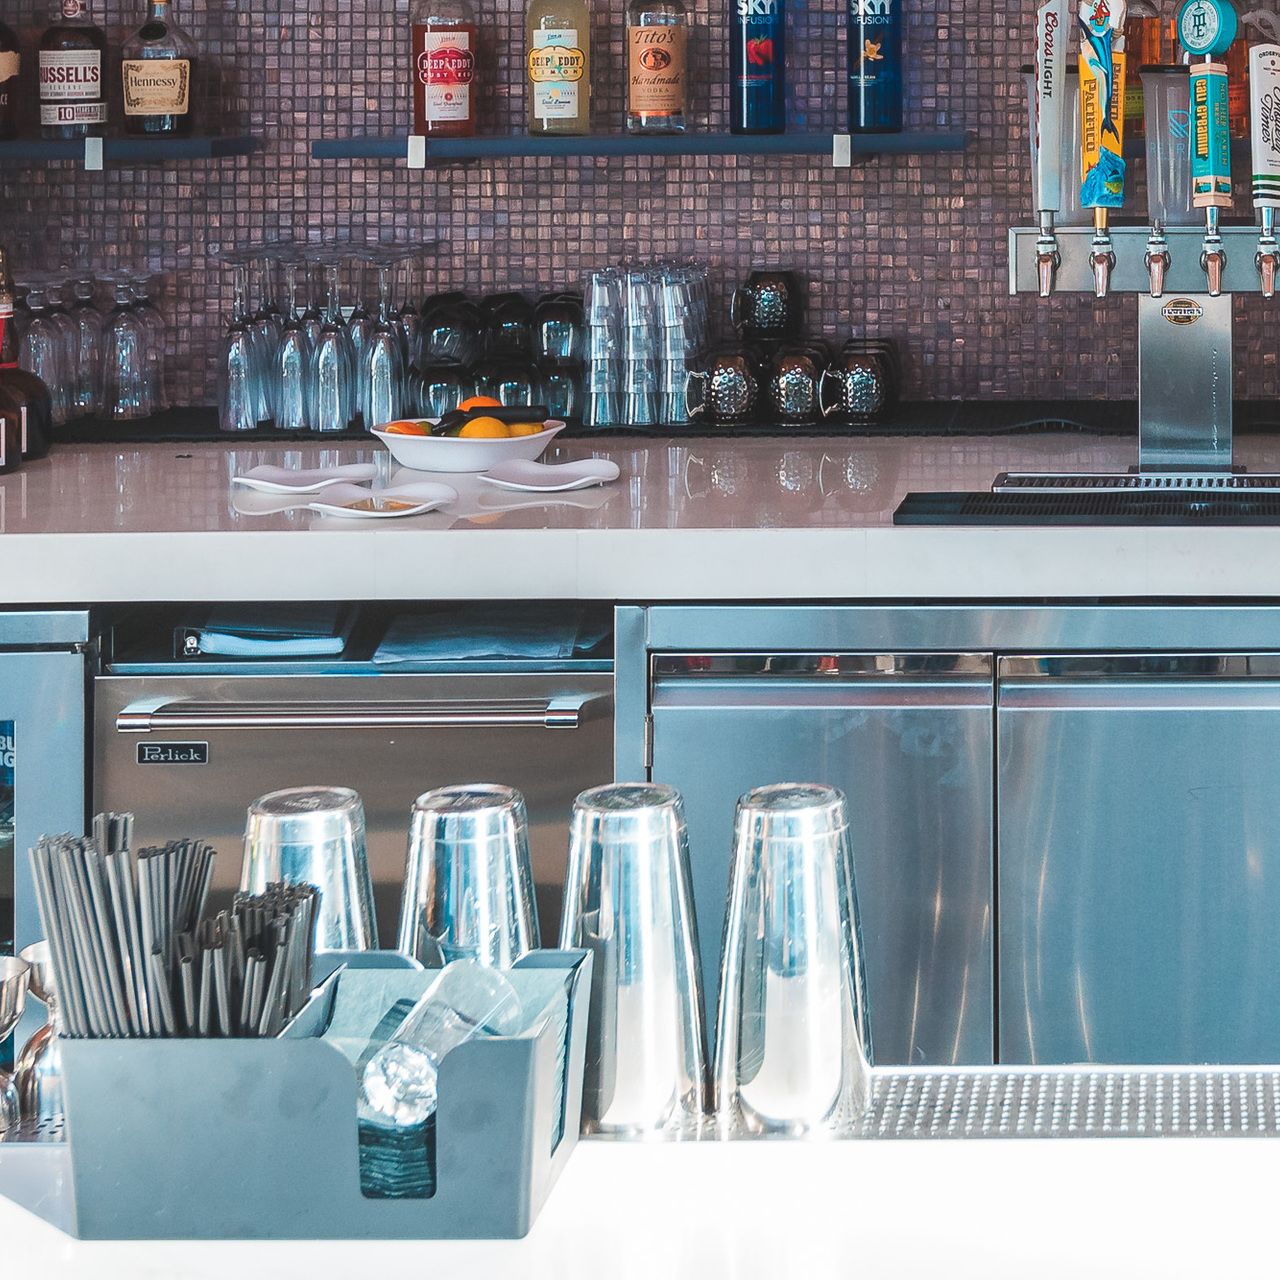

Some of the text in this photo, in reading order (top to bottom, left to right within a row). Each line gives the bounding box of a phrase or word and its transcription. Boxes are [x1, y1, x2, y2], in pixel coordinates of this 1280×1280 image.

[635, 29, 676, 44] Tito's
[1043, 11, 1059, 58] Coors
[422, 59, 471, 70] DEEP EDDY
[532, 56, 581, 67] DEEP EDDY
[130, 75, 178, 88] Hennessy
[631, 72, 680, 85] Handmade
[59, 107, 73, 120] 10
[1260, 92, 1274, 144] Times
[143, 746, 202, 762] Perlick
